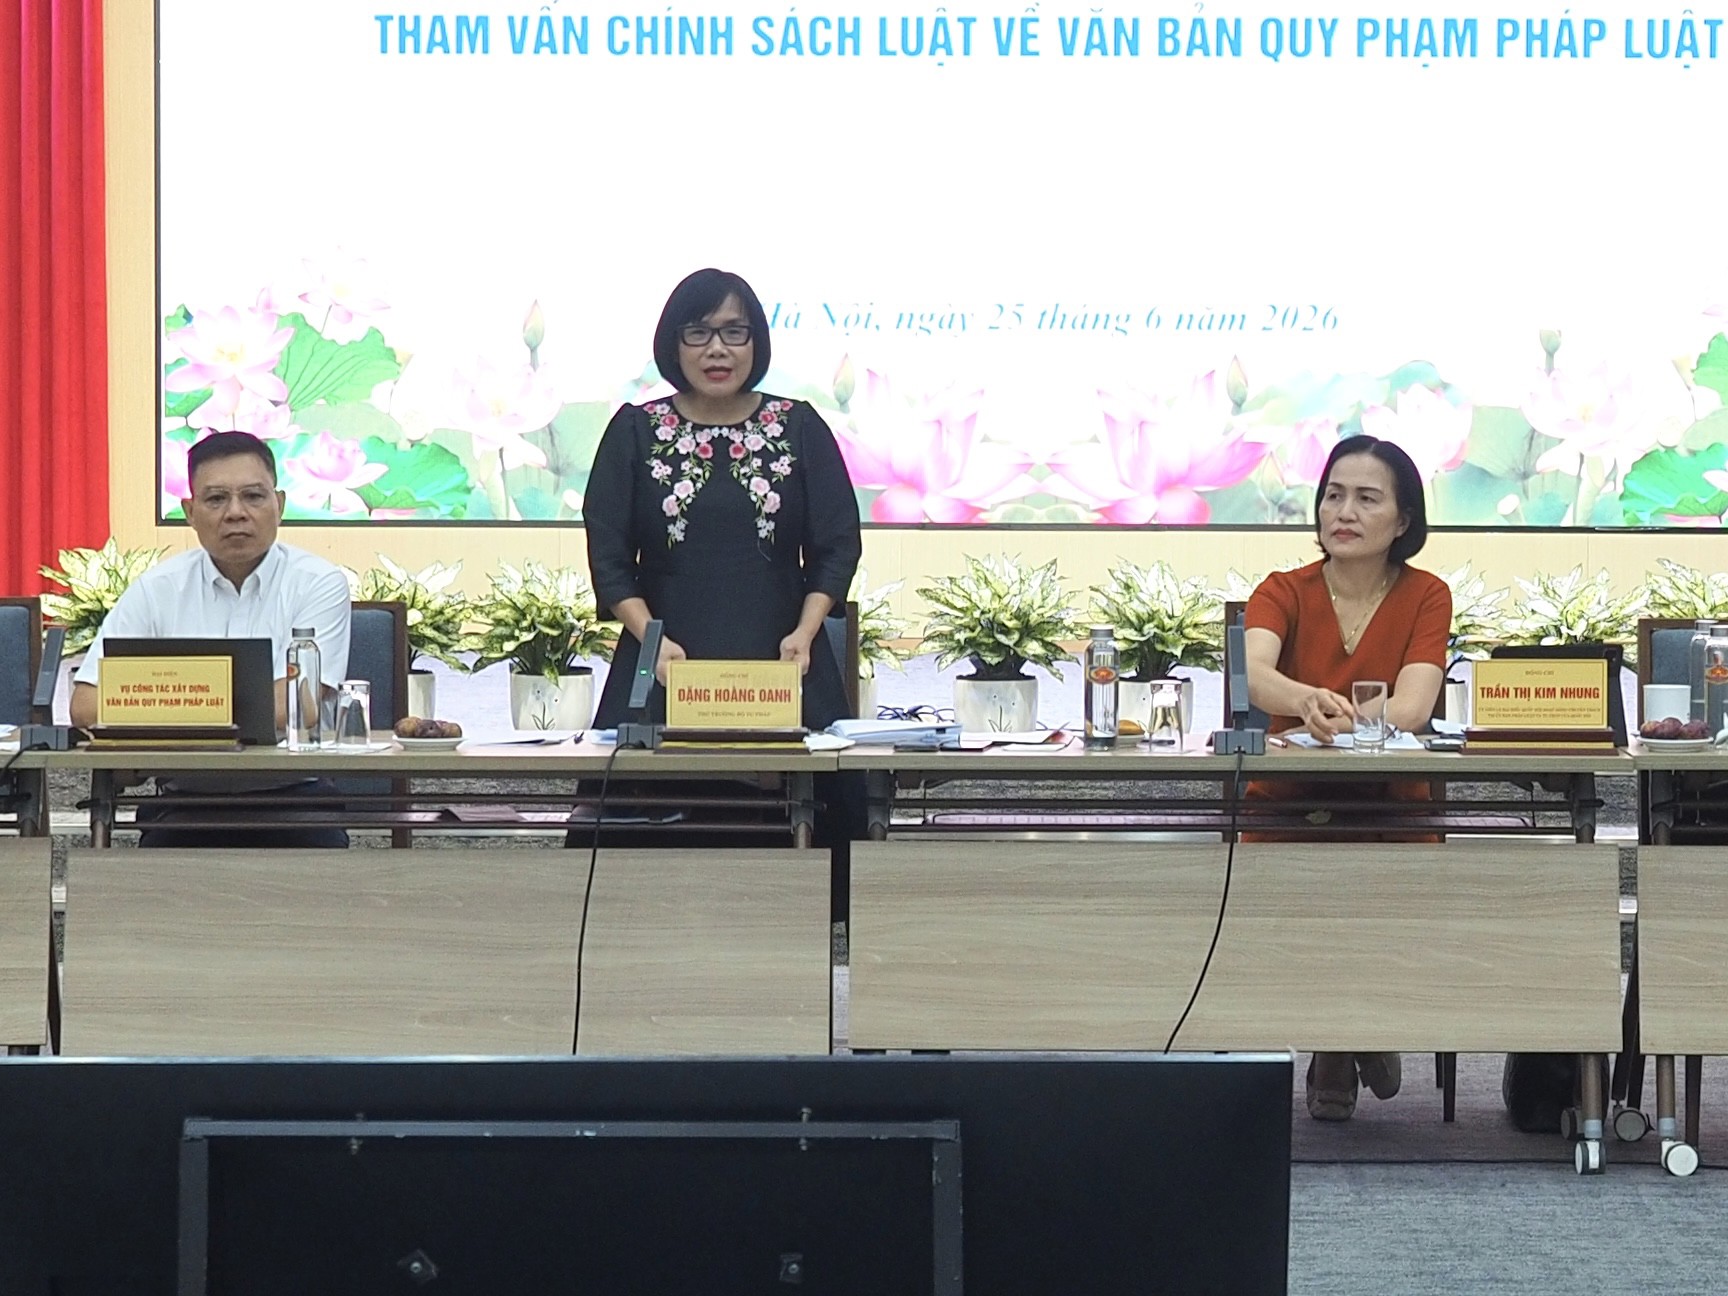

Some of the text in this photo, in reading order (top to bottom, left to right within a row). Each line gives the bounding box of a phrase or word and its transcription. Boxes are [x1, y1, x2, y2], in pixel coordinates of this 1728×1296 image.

[374, 0, 1726, 71] THAM VẤN CHÍNH SÁCH LUẬT VỀ VĂN BẢN QUY PHẠM PHÁP LUẬT
[987, 302, 1025, 332] 25
[1037, 301, 1132, 339] tháng
[1145, 304, 1163, 331] 6
[1261, 302, 1340, 332] 2026
[678, 686, 792, 706] ĐẶNG HOÀNG OANH
[1513, 687, 1531, 701] THỊ
[1534, 687, 1556, 699] KIM
[1560, 687, 1600, 699] NHUNG
